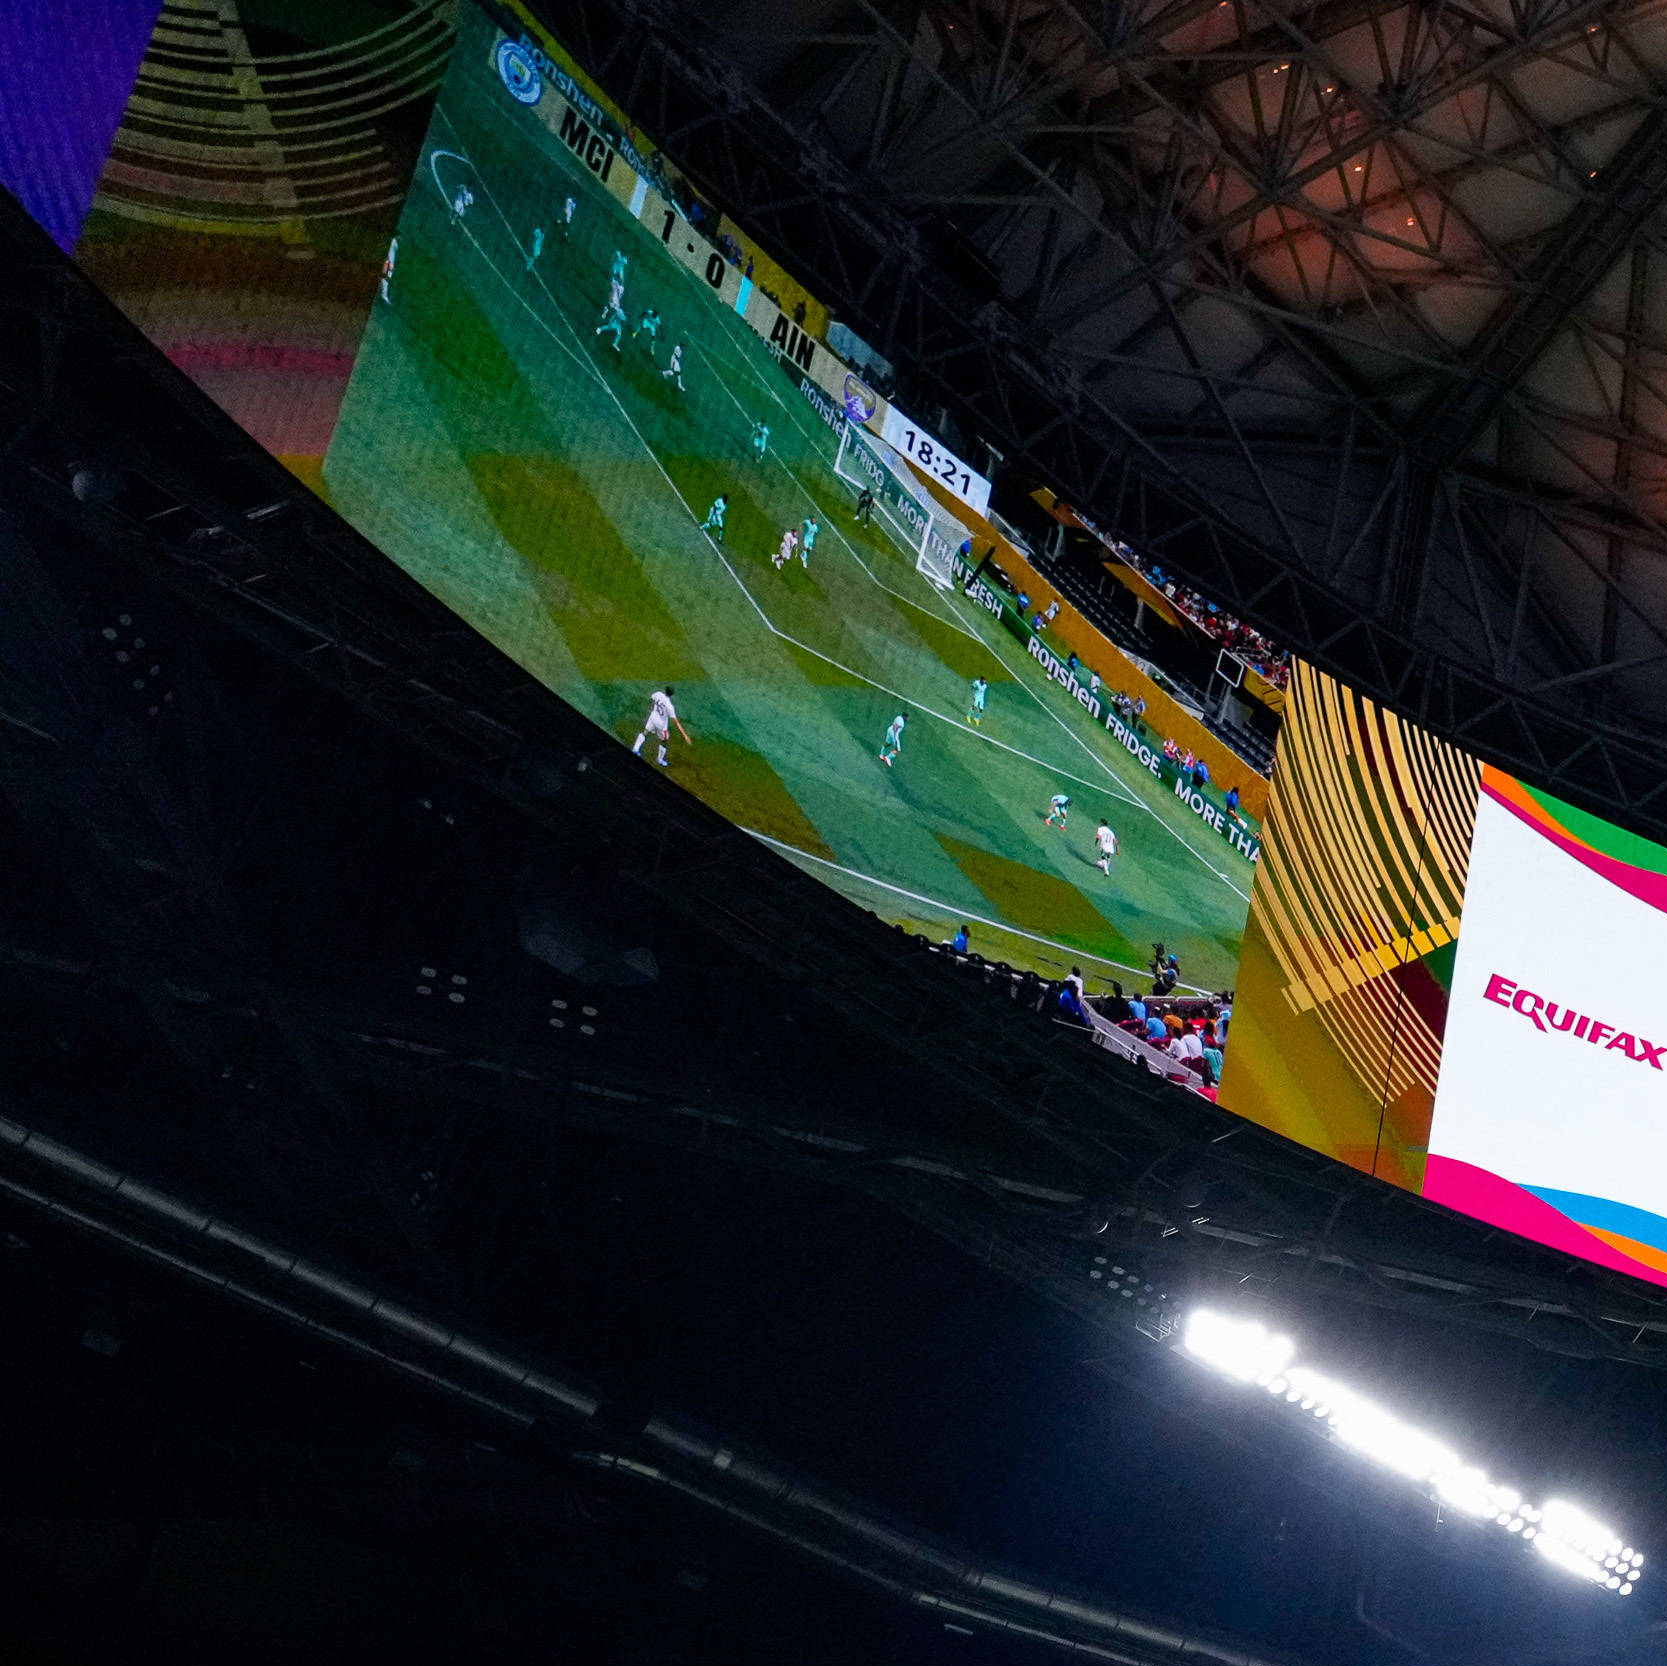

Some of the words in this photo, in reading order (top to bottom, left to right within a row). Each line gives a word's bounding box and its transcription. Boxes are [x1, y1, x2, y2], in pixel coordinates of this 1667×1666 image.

[560, 106, 615, 182] MCI
[769, 312, 817, 372] AIN
[904, 430, 972, 496] 18:21
[1027, 635, 1101, 719] Ronshen
[1173, 776, 1224, 835] MORE
